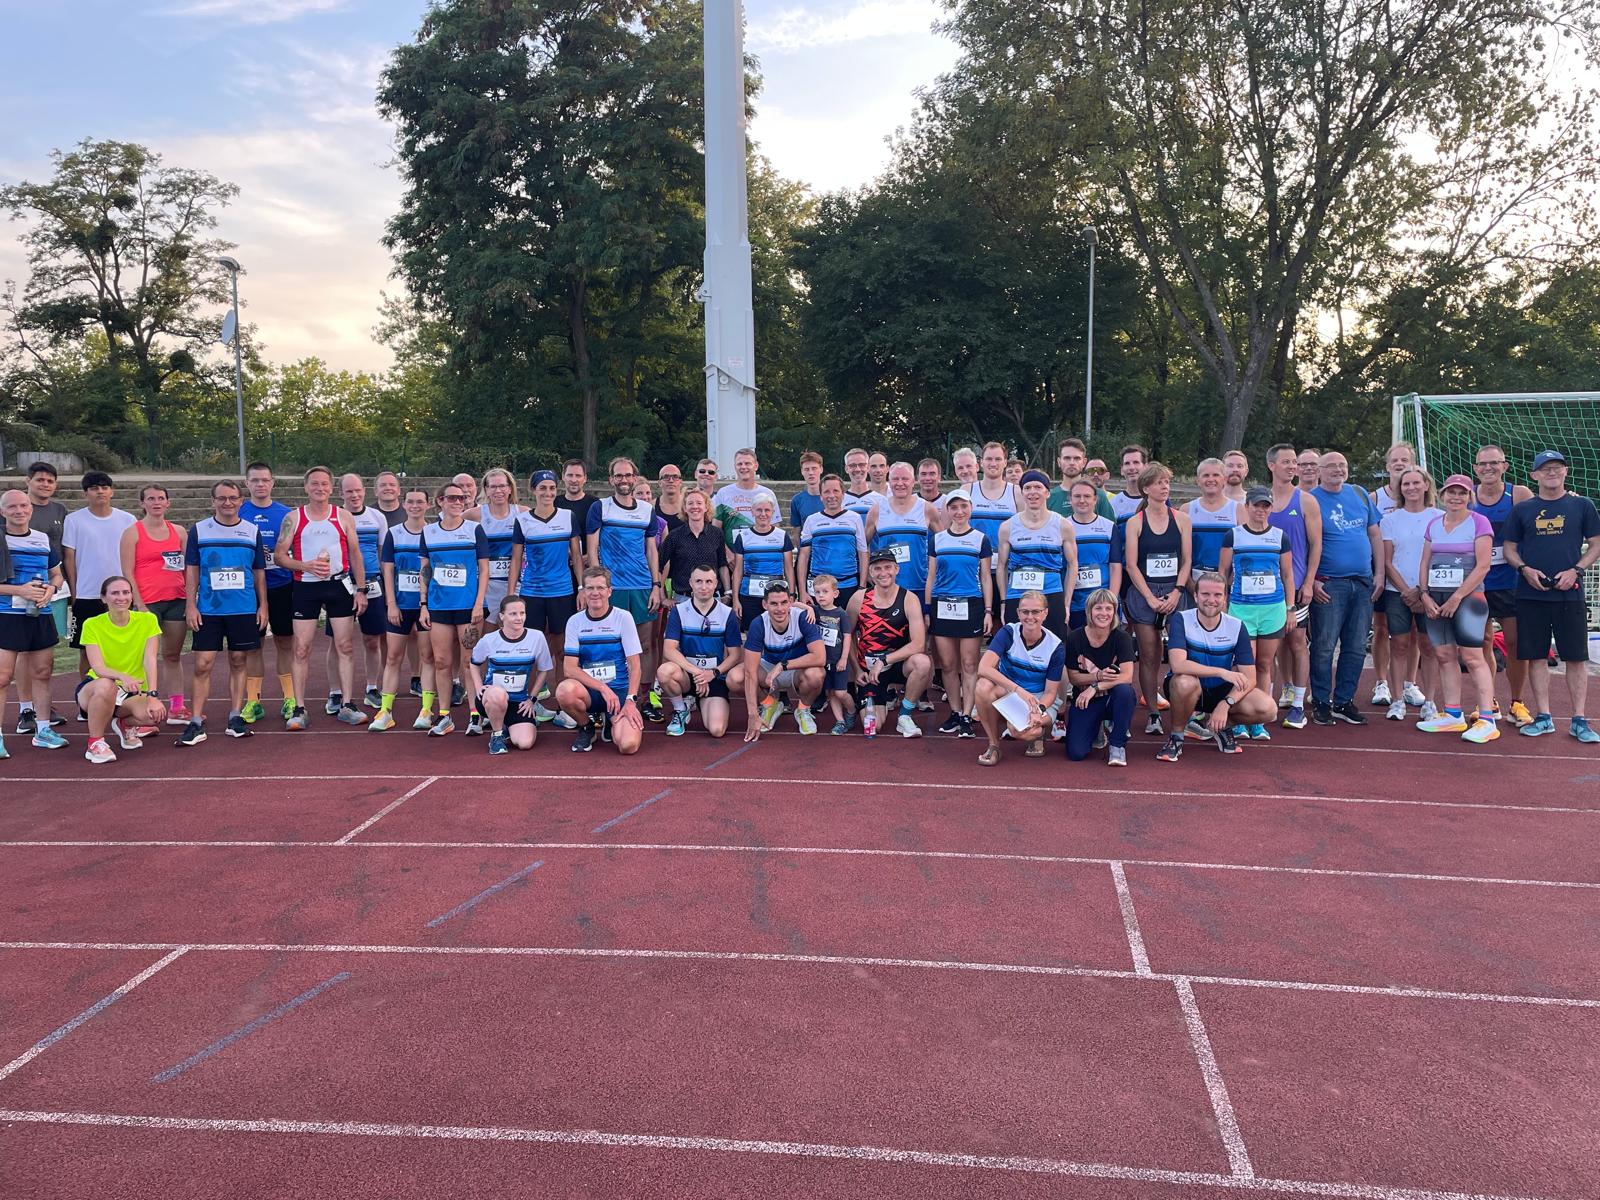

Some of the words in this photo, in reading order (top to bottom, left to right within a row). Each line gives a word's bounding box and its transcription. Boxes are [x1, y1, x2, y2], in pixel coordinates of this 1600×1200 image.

[1154, 560, 1172, 568] 202
[218, 572, 237, 581] 219
[441, 569, 459, 578] 162
[1020, 572, 1036, 580] 139
[1078, 571, 1094, 580] 136
[1435, 570, 1453, 578] 231
[1252, 576, 1265, 585] 78
[947, 603, 957, 611] 91
[695, 658, 706, 666] 79
[591, 667, 607, 677] 141
[503, 675, 515, 684] 51
